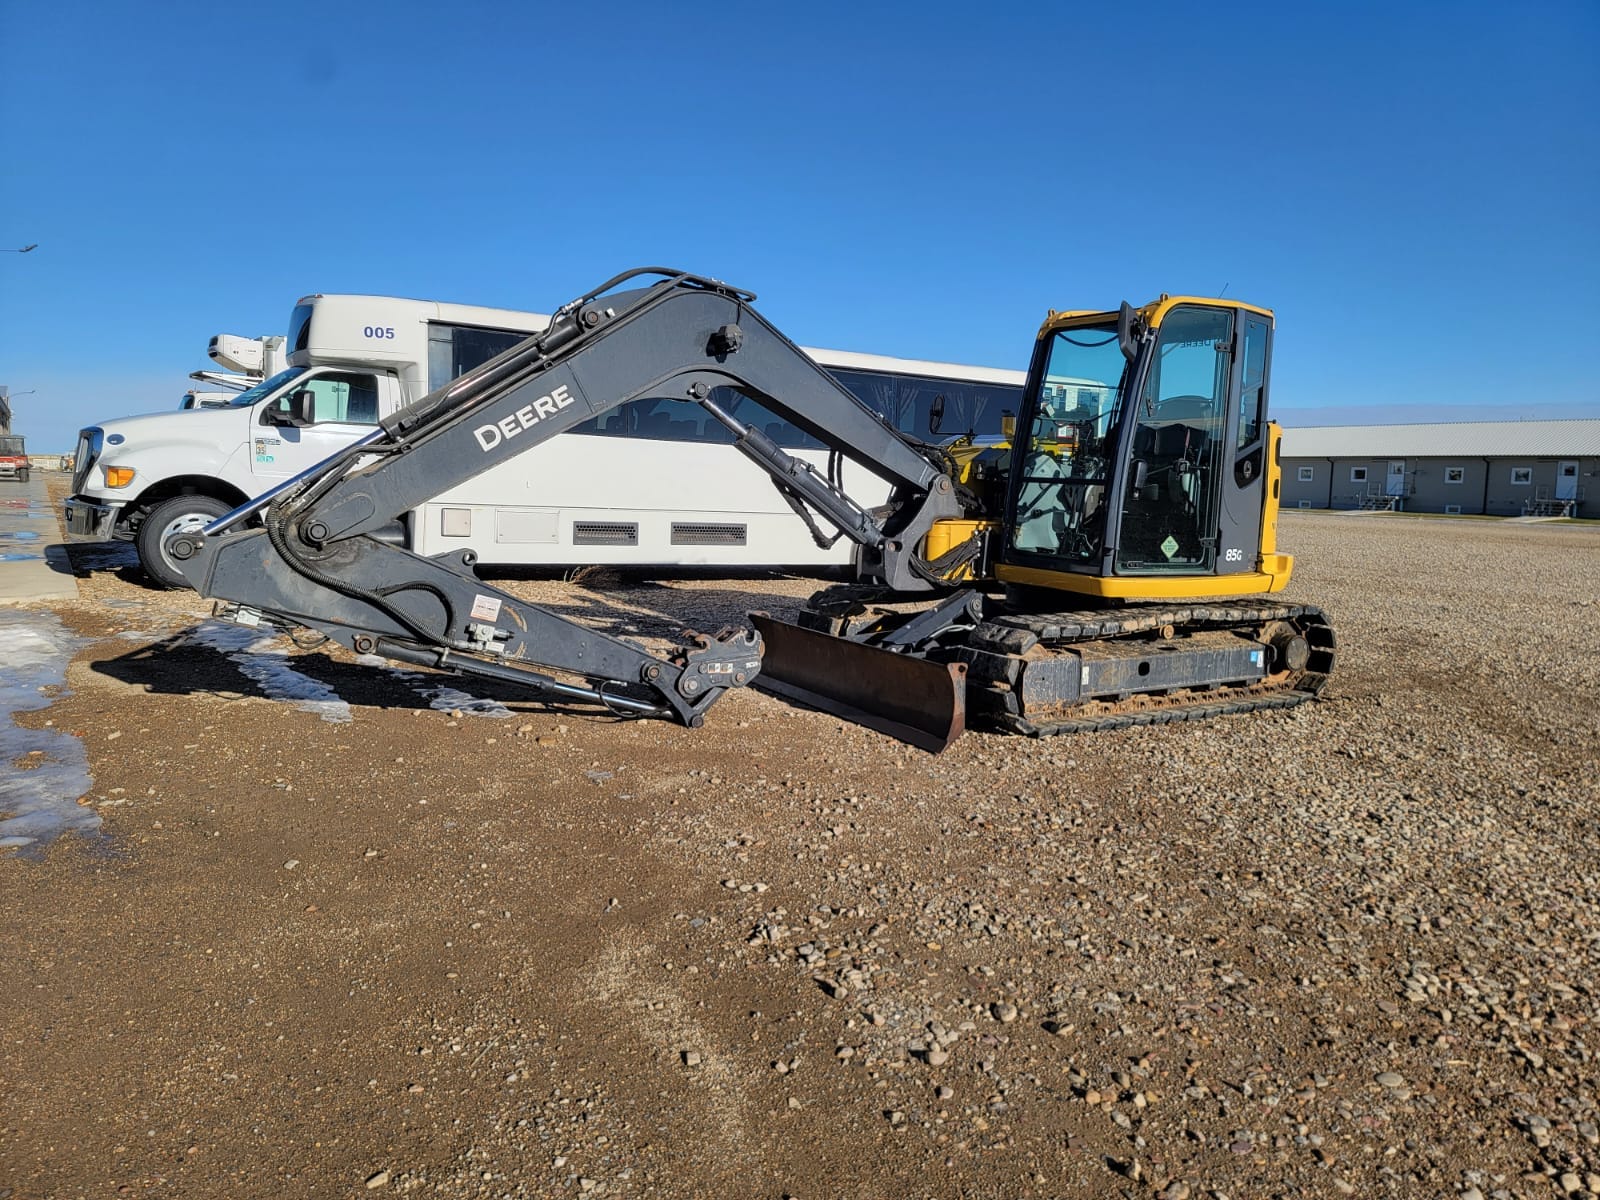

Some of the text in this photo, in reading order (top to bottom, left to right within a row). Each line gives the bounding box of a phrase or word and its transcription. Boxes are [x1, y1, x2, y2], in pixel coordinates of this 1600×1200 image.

[364, 326, 395, 340] 005
[473, 384, 575, 452] DEERE
[1226, 548, 1243, 562] 85G
